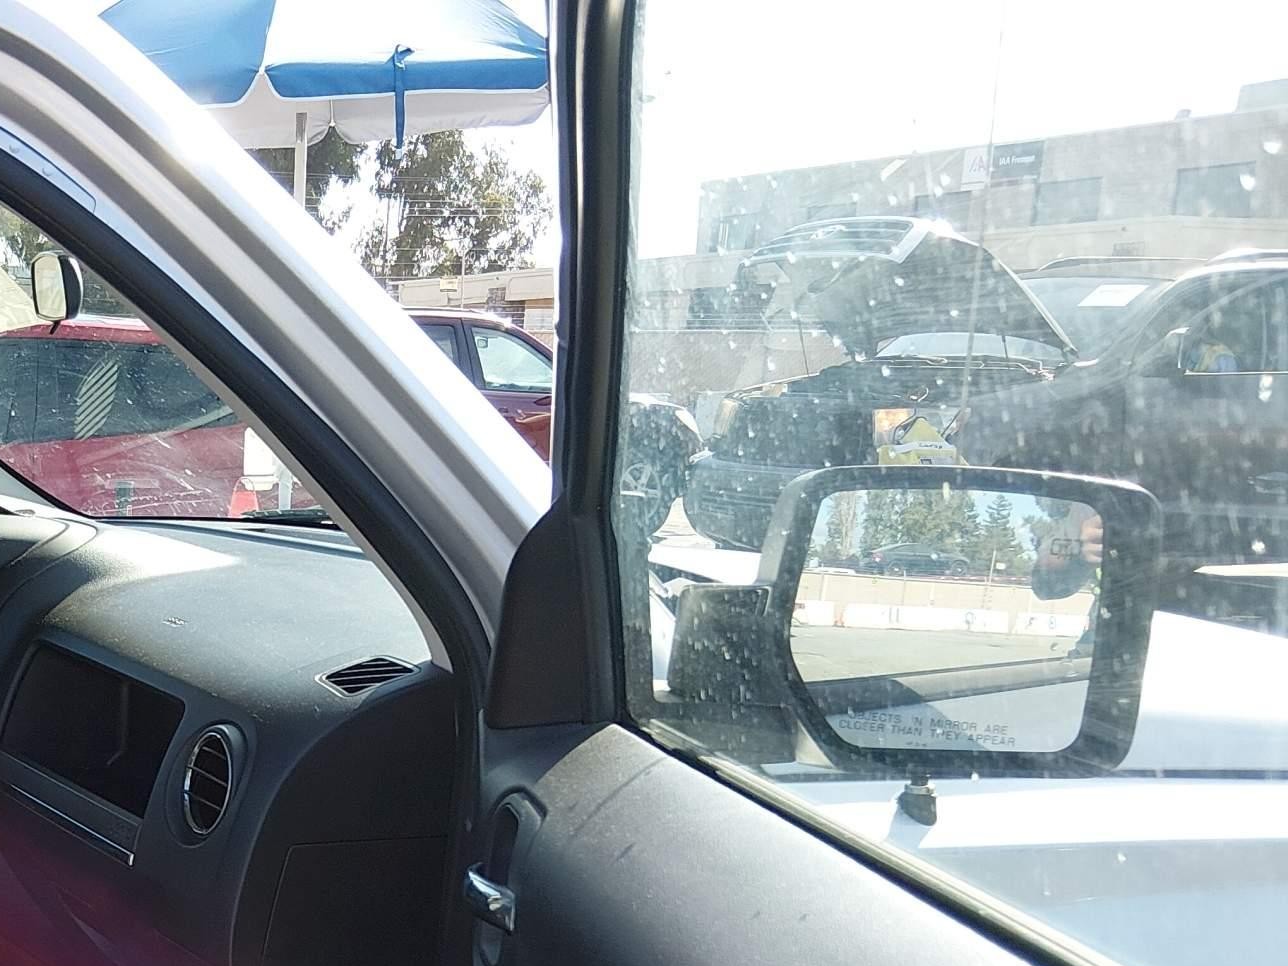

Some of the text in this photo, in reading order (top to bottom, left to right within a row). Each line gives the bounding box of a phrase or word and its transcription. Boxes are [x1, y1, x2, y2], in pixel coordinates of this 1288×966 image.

[838, 719, 1016, 747] CLOSER THAN THEY APPEAR
[848, 711, 902, 724] OBJECTS
[930, 718, 977, 732] MIRROR
[984, 724, 1008, 735] ARE
